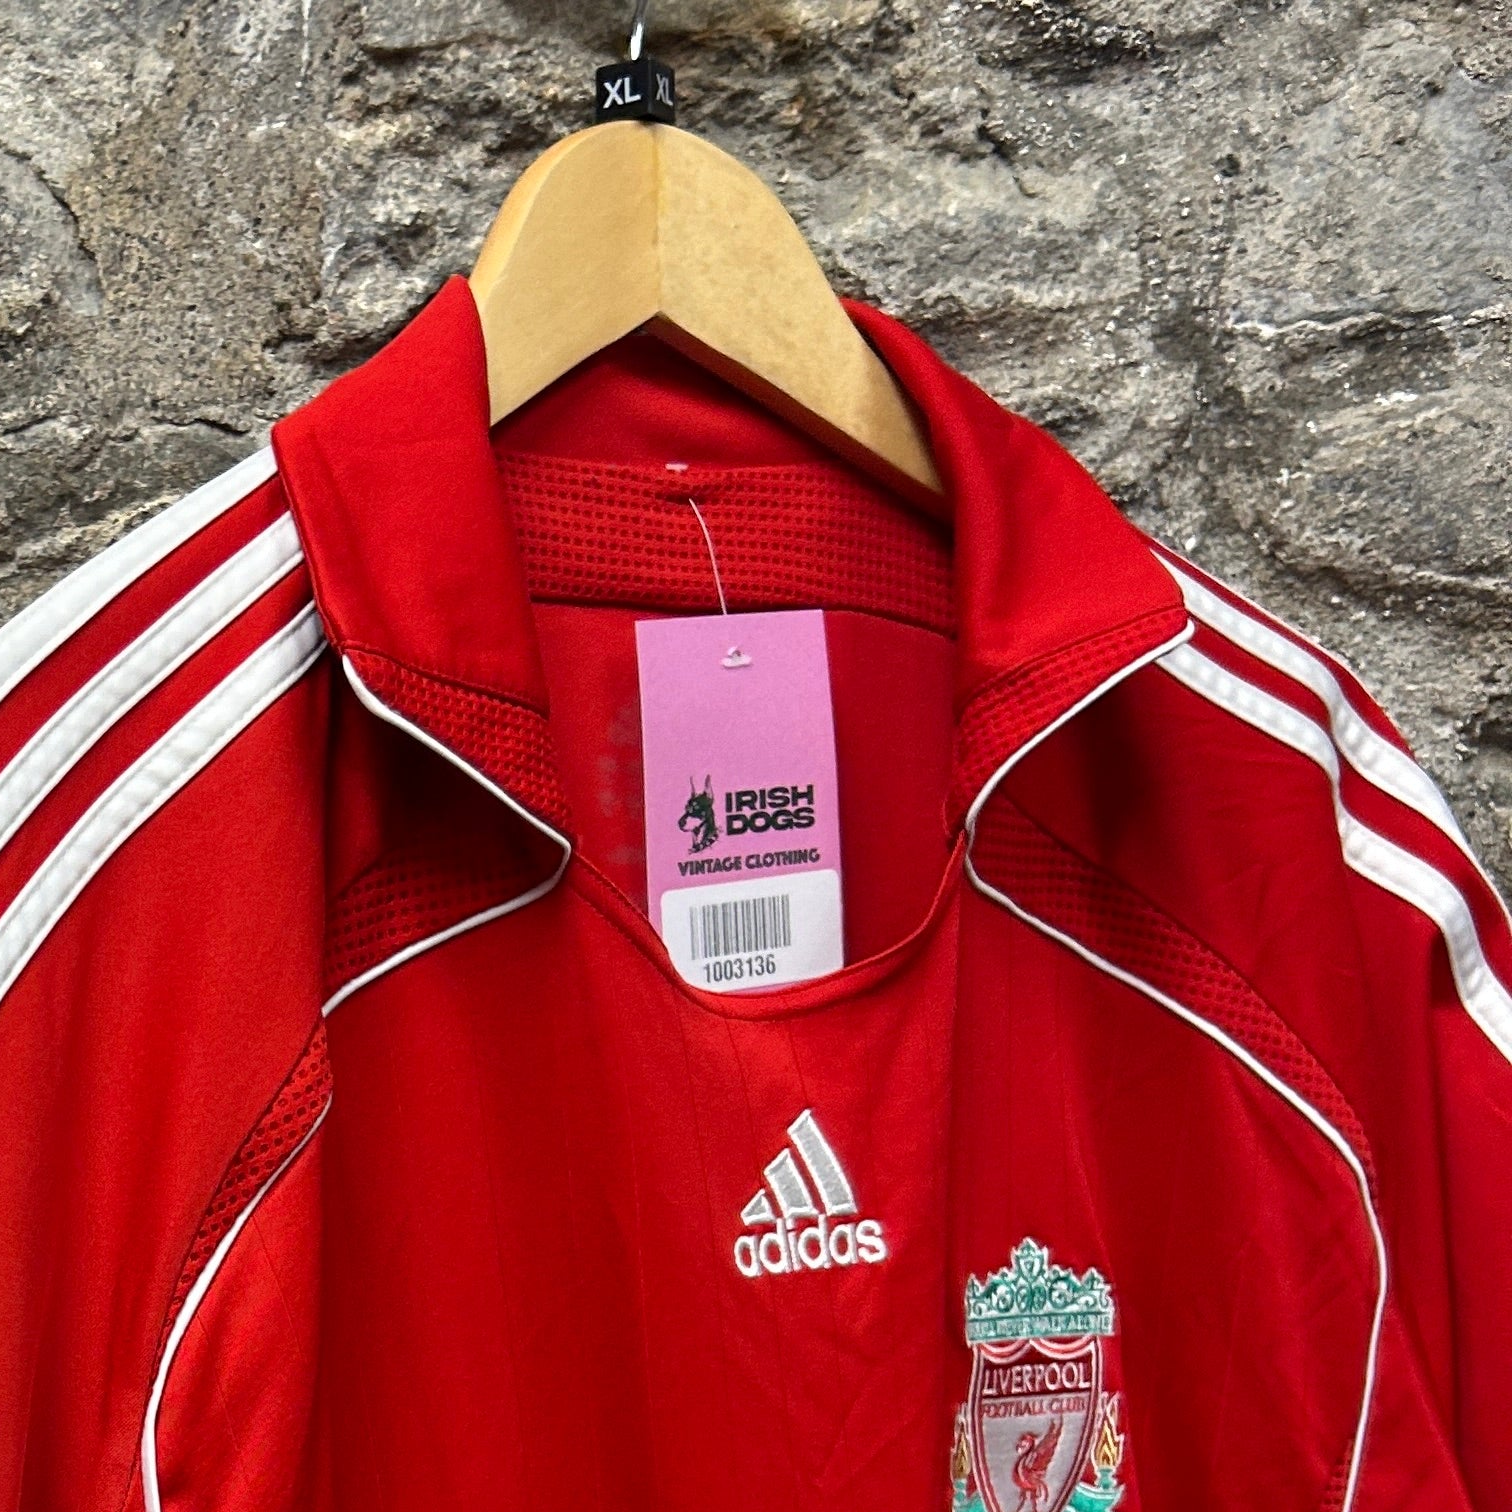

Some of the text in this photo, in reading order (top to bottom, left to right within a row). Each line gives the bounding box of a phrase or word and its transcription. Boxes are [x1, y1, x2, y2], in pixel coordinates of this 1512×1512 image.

[603, 77, 641, 109] XL
[655, 73, 674, 107] XL
[725, 784, 815, 813] IRISH
[725, 807, 816, 836] DOGS
[678, 848, 821, 876] VINTAGE CLOTHING
[703, 954, 777, 983] 1003136
[734, 1213, 888, 1278] adidas
[983, 1361, 1091, 1395] LIVERPOOL
